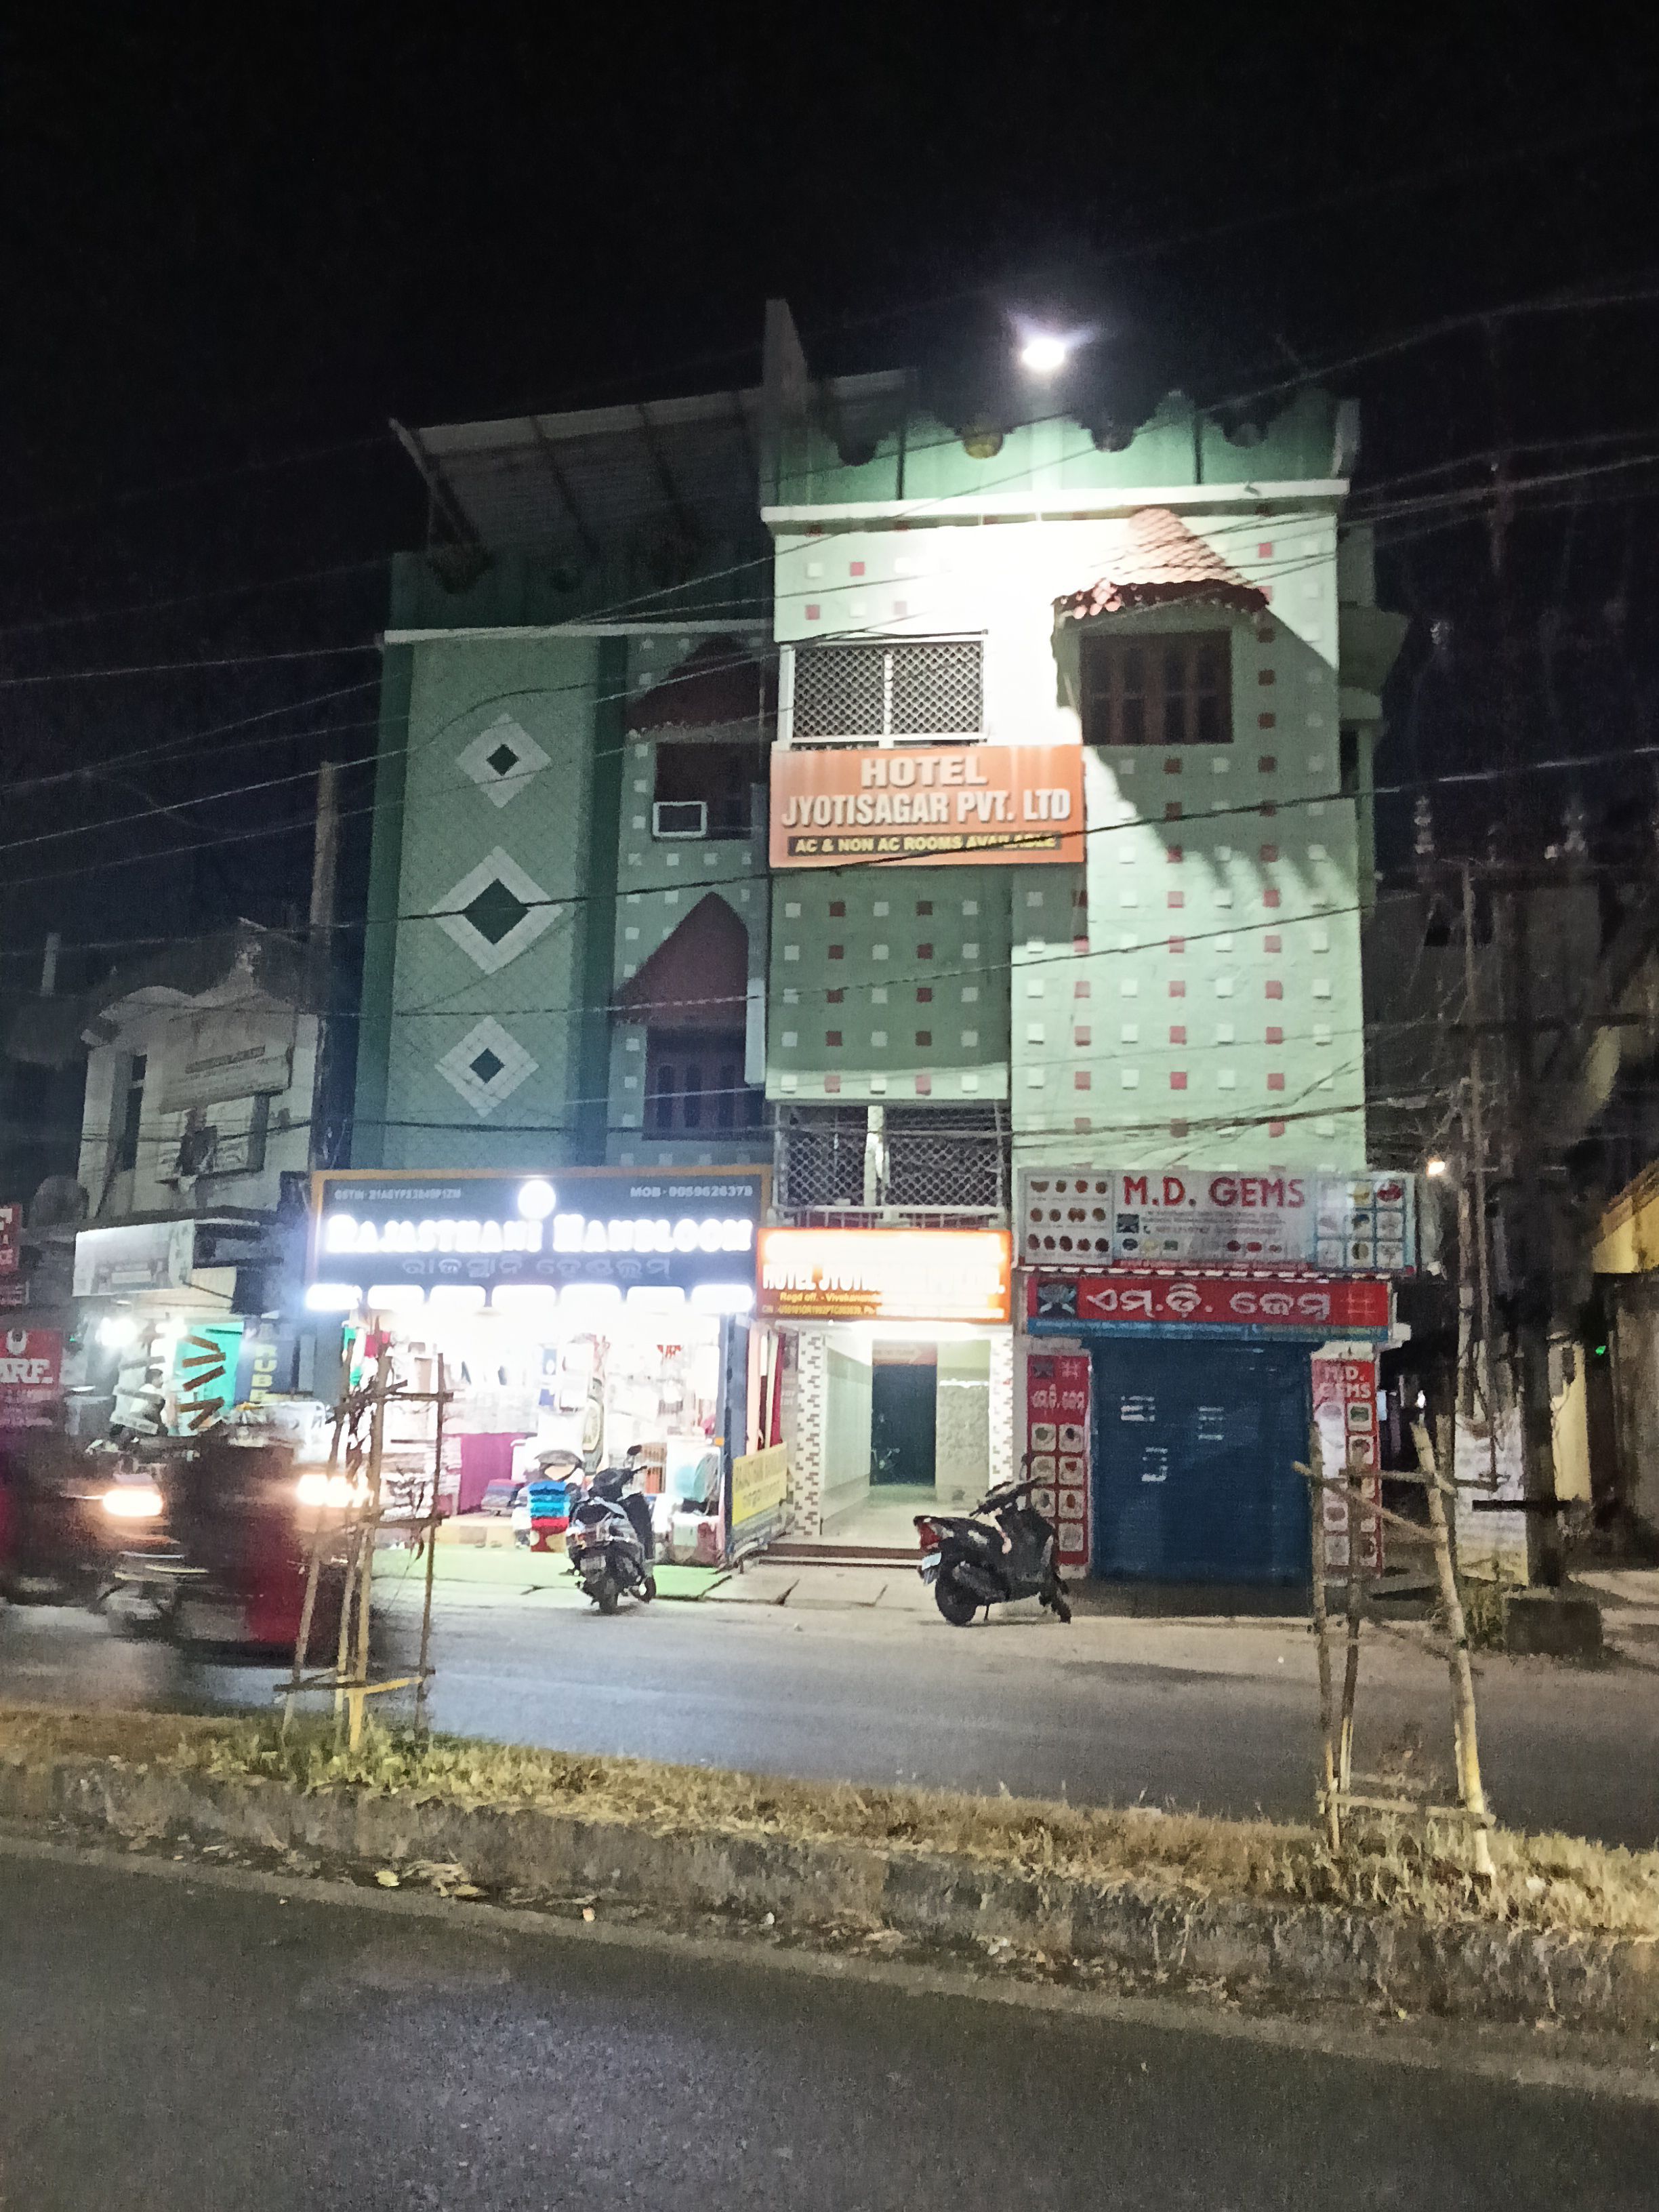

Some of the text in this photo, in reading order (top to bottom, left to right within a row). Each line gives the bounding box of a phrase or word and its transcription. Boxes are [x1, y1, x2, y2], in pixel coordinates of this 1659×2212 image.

[861, 755, 987, 788] HOTEL
[782, 788, 1071, 827] JYOTISAGAR PVT. LTD
[795, 838, 817, 853] AC
[821, 838, 834, 852] &
[838, 837, 874, 852] NON
[878, 836, 901, 851] AC
[904, 834, 962, 851] ROOMS
[1123, 1176, 1305, 1208] M.D. GEMS
